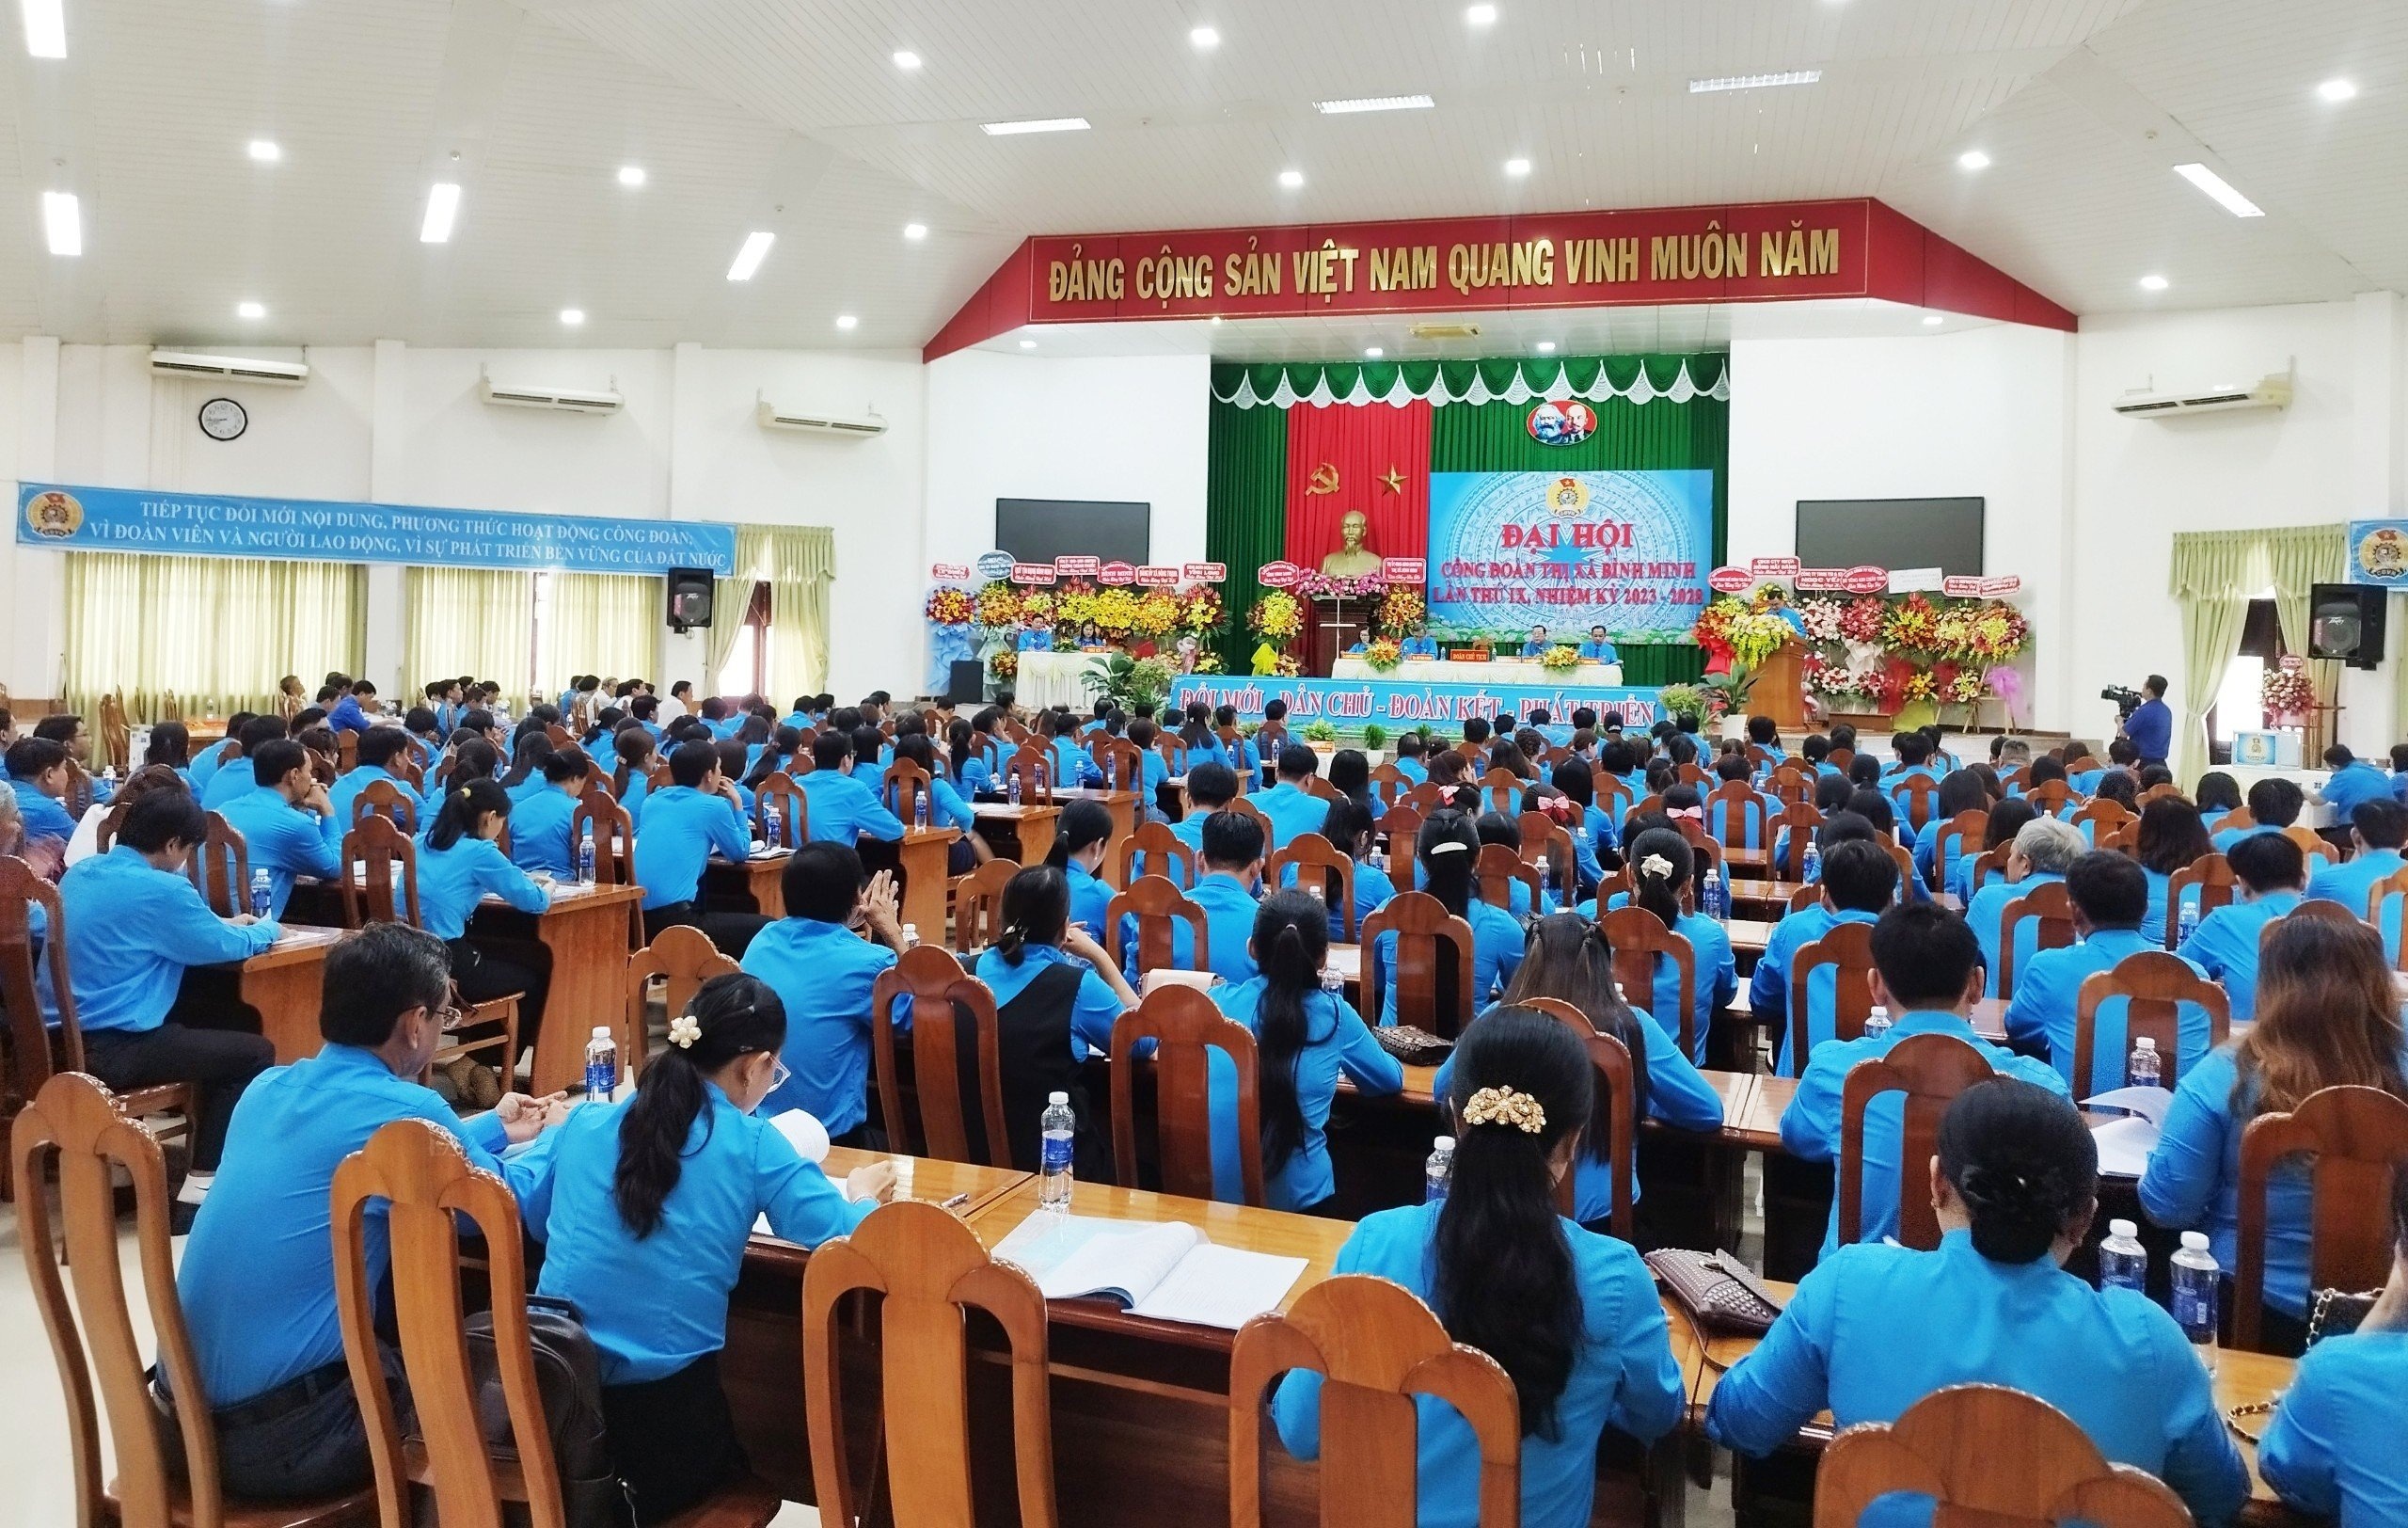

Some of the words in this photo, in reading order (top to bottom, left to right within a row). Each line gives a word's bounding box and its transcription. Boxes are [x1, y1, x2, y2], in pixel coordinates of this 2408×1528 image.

[1049, 243, 1125, 302] ĐẢNG
[1135, 245, 1213, 310] CỘNG
[1224, 235, 1281, 296] SẢN
[1292, 238, 1359, 303] VIỆT
[1370, 246, 1437, 292] NAM
[1448, 239, 1555, 296] QUANG
[1564, 237, 1639, 284] VINH
[1651, 219, 1748, 281] MUÔN
[1761, 219, 1839, 278] NĂM
[140, 499, 182, 518] TIẾP
[183, 504, 222, 521] TỤC
[226, 501, 257, 523] ĐỔI
[262, 505, 296, 525] MỚI
[301, 509, 331, 530] NỘI
[336, 513, 388, 531] DUNG,
[391, 515, 460, 533] PHƯƠNG
[464, 516, 509, 536] THỨC
[512, 524, 554, 542] HOẠT
[557, 525, 599, 544] ĐỘNG
[603, 524, 645, 542] CÔNG
[1501, 522, 1561, 555] ĐẠI
[1572, 518, 1634, 555] HỘI
[90, 519, 109, 539] VÌ
[115, 521, 166, 541] ĐOÀN
[171, 522, 214, 544] VIÊN
[219, 526, 244, 546] VÀ
[247, 529, 305, 548] NGƯỜI
[310, 533, 345, 549] LAO
[350, 533, 401, 554] ĐỘNG,
[404, 535, 422, 553] VÌ
[426, 538, 449, 558] SỰ
[451, 538, 492, 557] PHÁT
[496, 539, 541, 559] TRIỂN
[545, 542, 574, 560] BỀN
[578, 544, 621, 563] VỮNG
[624, 547, 654, 565] CỦA
[657, 549, 684, 565] ĐẤT
[689, 550, 727, 567] NƯỚC
[1441, 557, 1486, 579] CÔNG
[1489, 558, 1535, 579] ĐOÀN
[1542, 562, 1570, 583] THỊ
[1573, 558, 1597, 579] XÃ
[1602, 557, 1644, 580] BÌNH
[1648, 562, 1696, 580] MINH
[1433, 578, 1466, 603] LẦN
[1470, 581, 1505, 603] THỨ
[1509, 587, 1531, 605] IX,
[1535, 584, 1591, 607] NHIỆM
[1595, 582, 1620, 605] KỲ
[1624, 587, 1656, 605] 2023
[1670, 588, 1703, 606] 2028
[1221, 682, 1264, 714] MỚI
[1280, 683, 1327, 717] DÂN
[1327, 686, 1375, 718] CHỦ
[1389, 687, 1451, 721] ĐOÀN
[1456, 689, 1503, 723] KẾT
